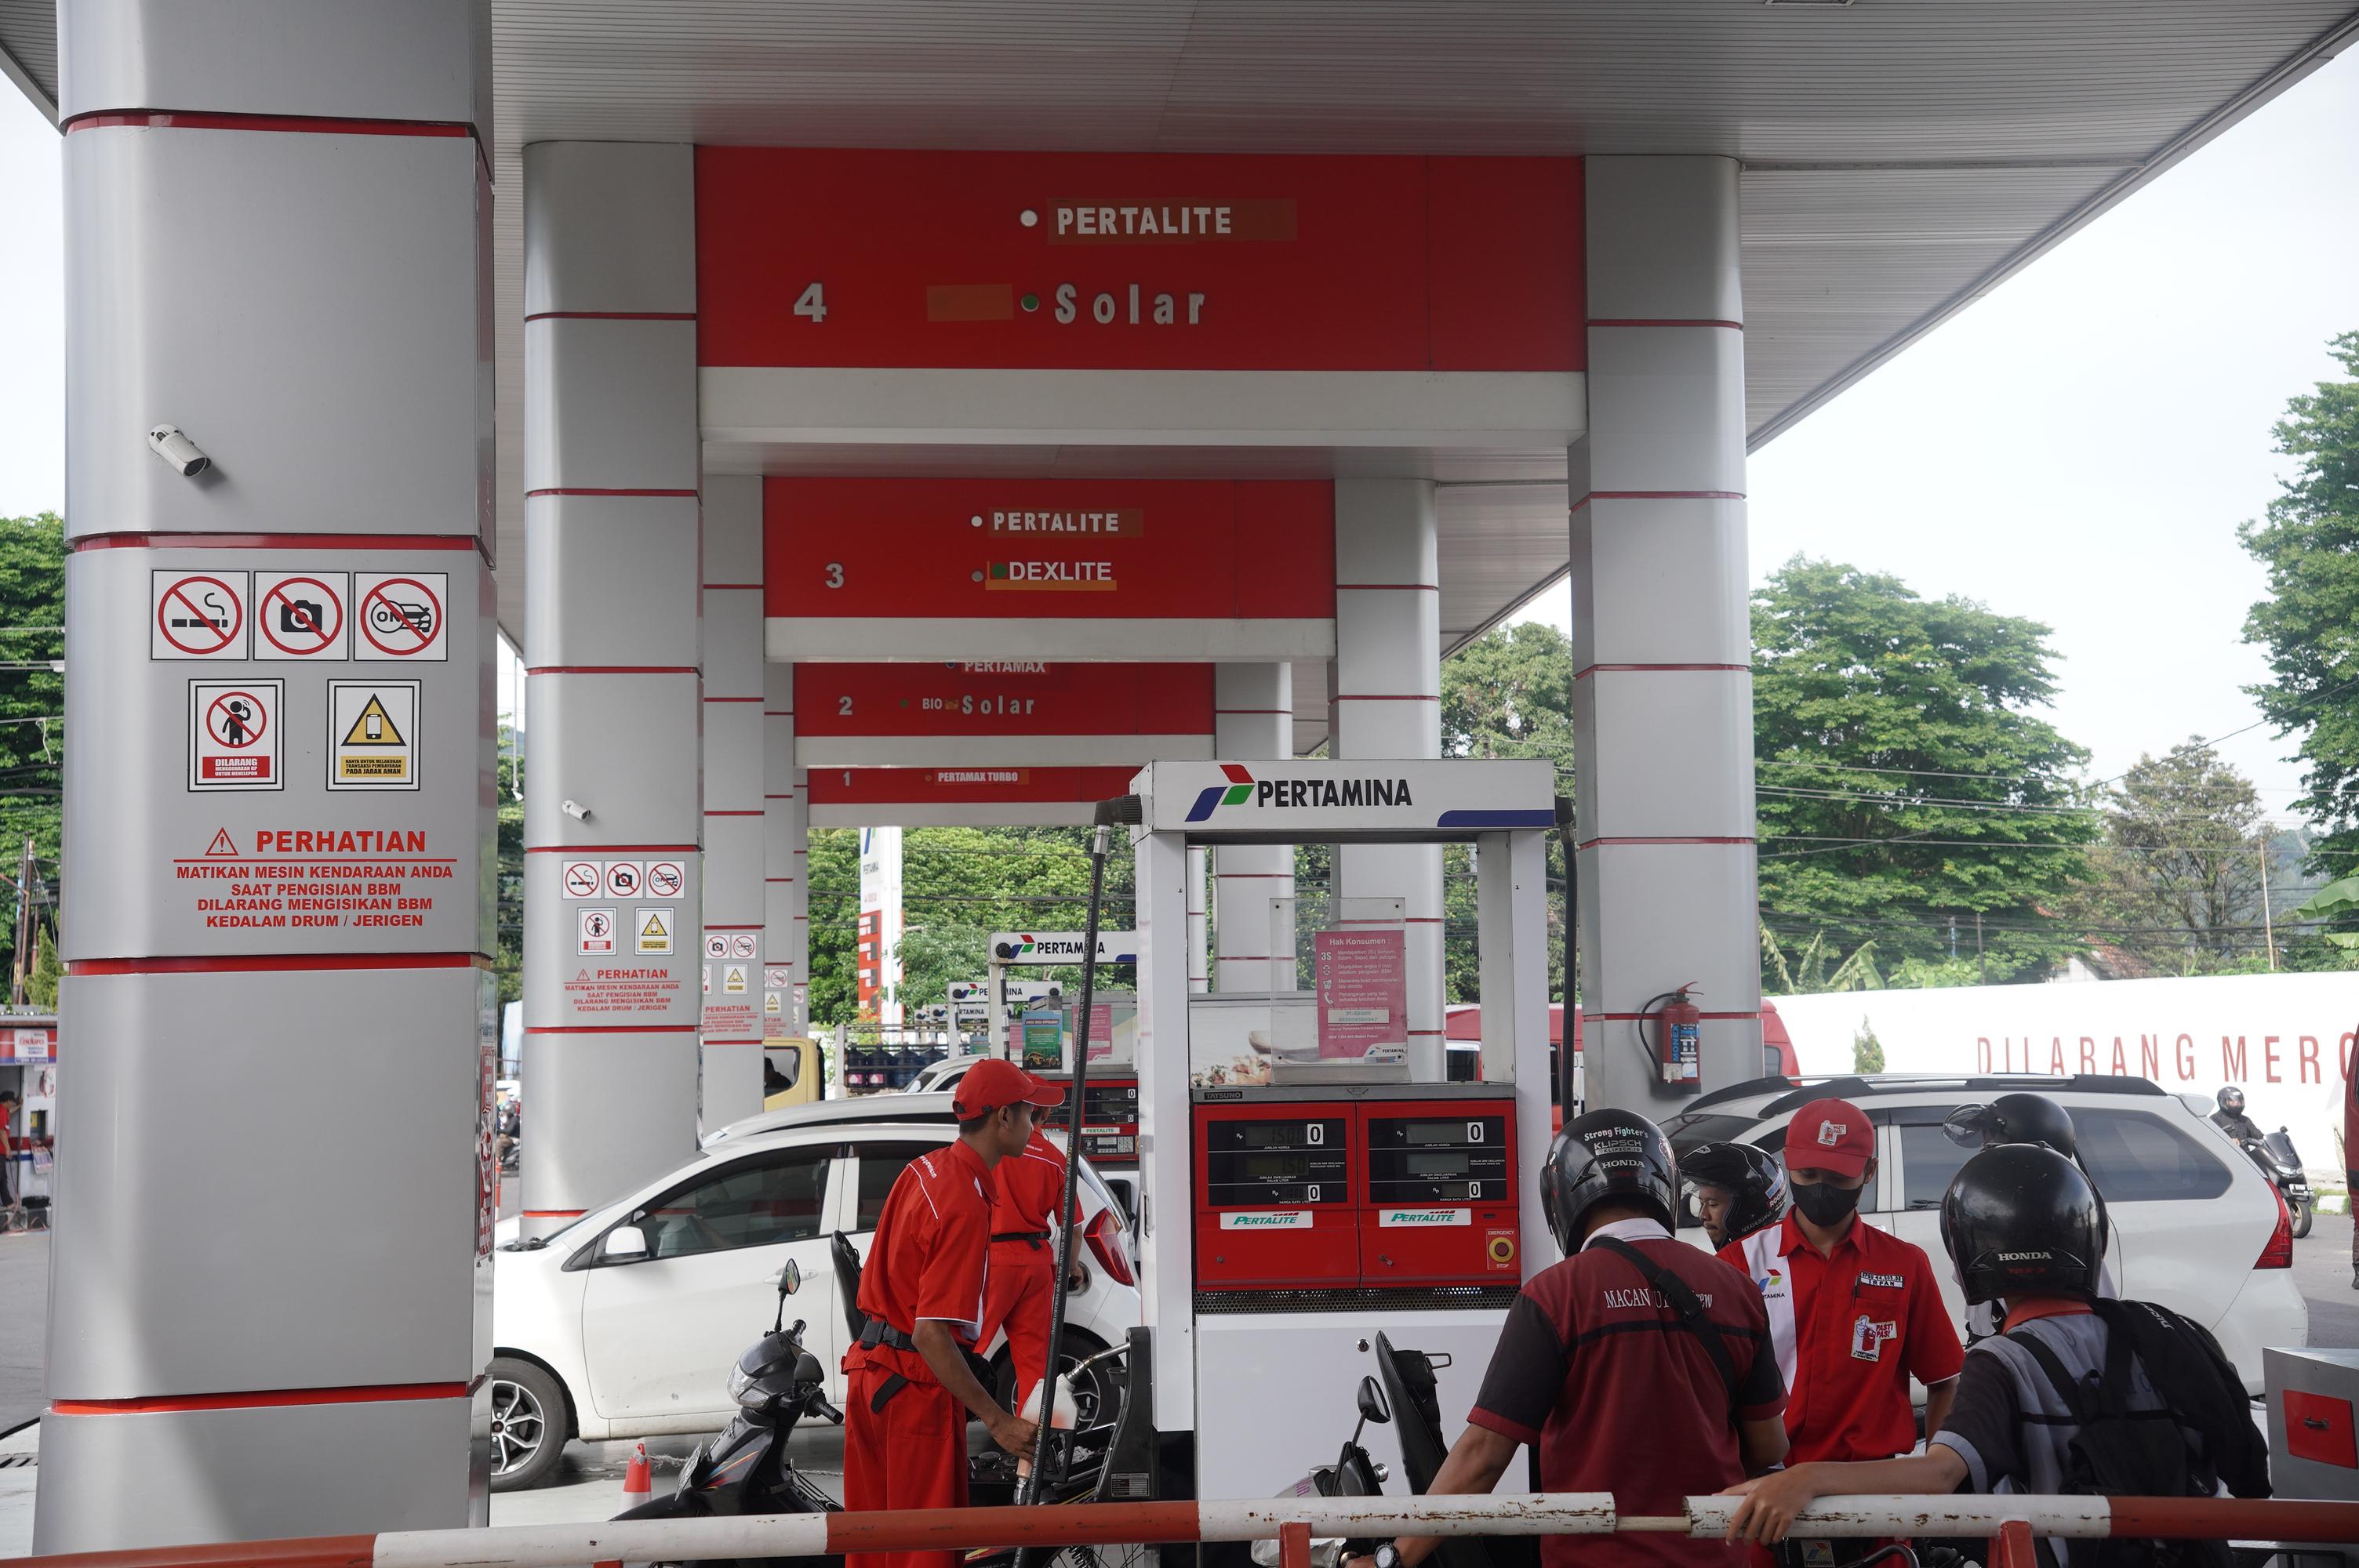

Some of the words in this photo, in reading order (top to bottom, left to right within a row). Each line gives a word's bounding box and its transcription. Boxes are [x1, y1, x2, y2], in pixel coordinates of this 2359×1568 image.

[1057, 206, 1231, 234] PERTALITE
[794, 282, 827, 323] 4
[1055, 284, 1205, 324] Solar
[994, 512, 1119, 532] PERTALITE
[825, 563, 845, 589] 3
[1009, 561, 1112, 581] DEXLITE
[965, 662, 1046, 673] PERTAMAX
[838, 695, 853, 716] 2
[921, 698, 943, 710] BIO
[961, 695, 1035, 716] Solar
[215, 758, 258, 767] DILARANG
[843, 771, 851, 787] 1
[938, 771, 987, 782] PERTAMAX
[987, 771, 1019, 782] TURBO
[1257, 779, 1413, 808] PERTAMINA
[256, 830, 426, 853] PERHATIAN
[176, 866, 249, 879] MATIKAN
[255, 866, 304, 879] MESIN
[309, 866, 406, 878] KENDARAAN
[410, 866, 453, 878] ANDA
[231, 883, 272, 896] SAAT
[277, 883, 362, 896] PENGISIAN
[367, 883, 402, 895] BBM
[197, 898, 283, 911] DILARANG
[288, 898, 392, 911] MENGISIKAN
[397, 898, 432, 910] BBM
[206, 915, 285, 927] KEDALAM
[291, 915, 339, 927] DRUM
[343, 915, 349, 927] /
[353, 914, 423, 927] JERIGEN
[1037, 942, 1106, 955] PERTAMA
[1321, 952, 1332, 961] 3S
[597, 969, 668, 979] PERHATIAN
[705, 1004, 751, 1013] PERHATIAN
[1977, 1033, 2196, 1081] DILARANG
[1310, 1126, 1321, 1143] 0
[1470, 1123, 1481, 1141] 0
[1584, 1129, 1613, 1142] Strong
[1613, 1127, 1649, 1139] Fighter's
[1594, 1139, 1642, 1151] KLIPSCH
[1601, 1160, 1646, 1170] HONDA
[1310, 1186, 1318, 1200] 0
[1470, 1183, 1479, 1196] 0
[1233, 1216, 1298, 1225] PERTALITE
[1390, 1213, 1456, 1222] PERTALITE
[1997, 1251, 2052, 1261] HONDA
[1604, 1287, 1652, 1309] MACAN
